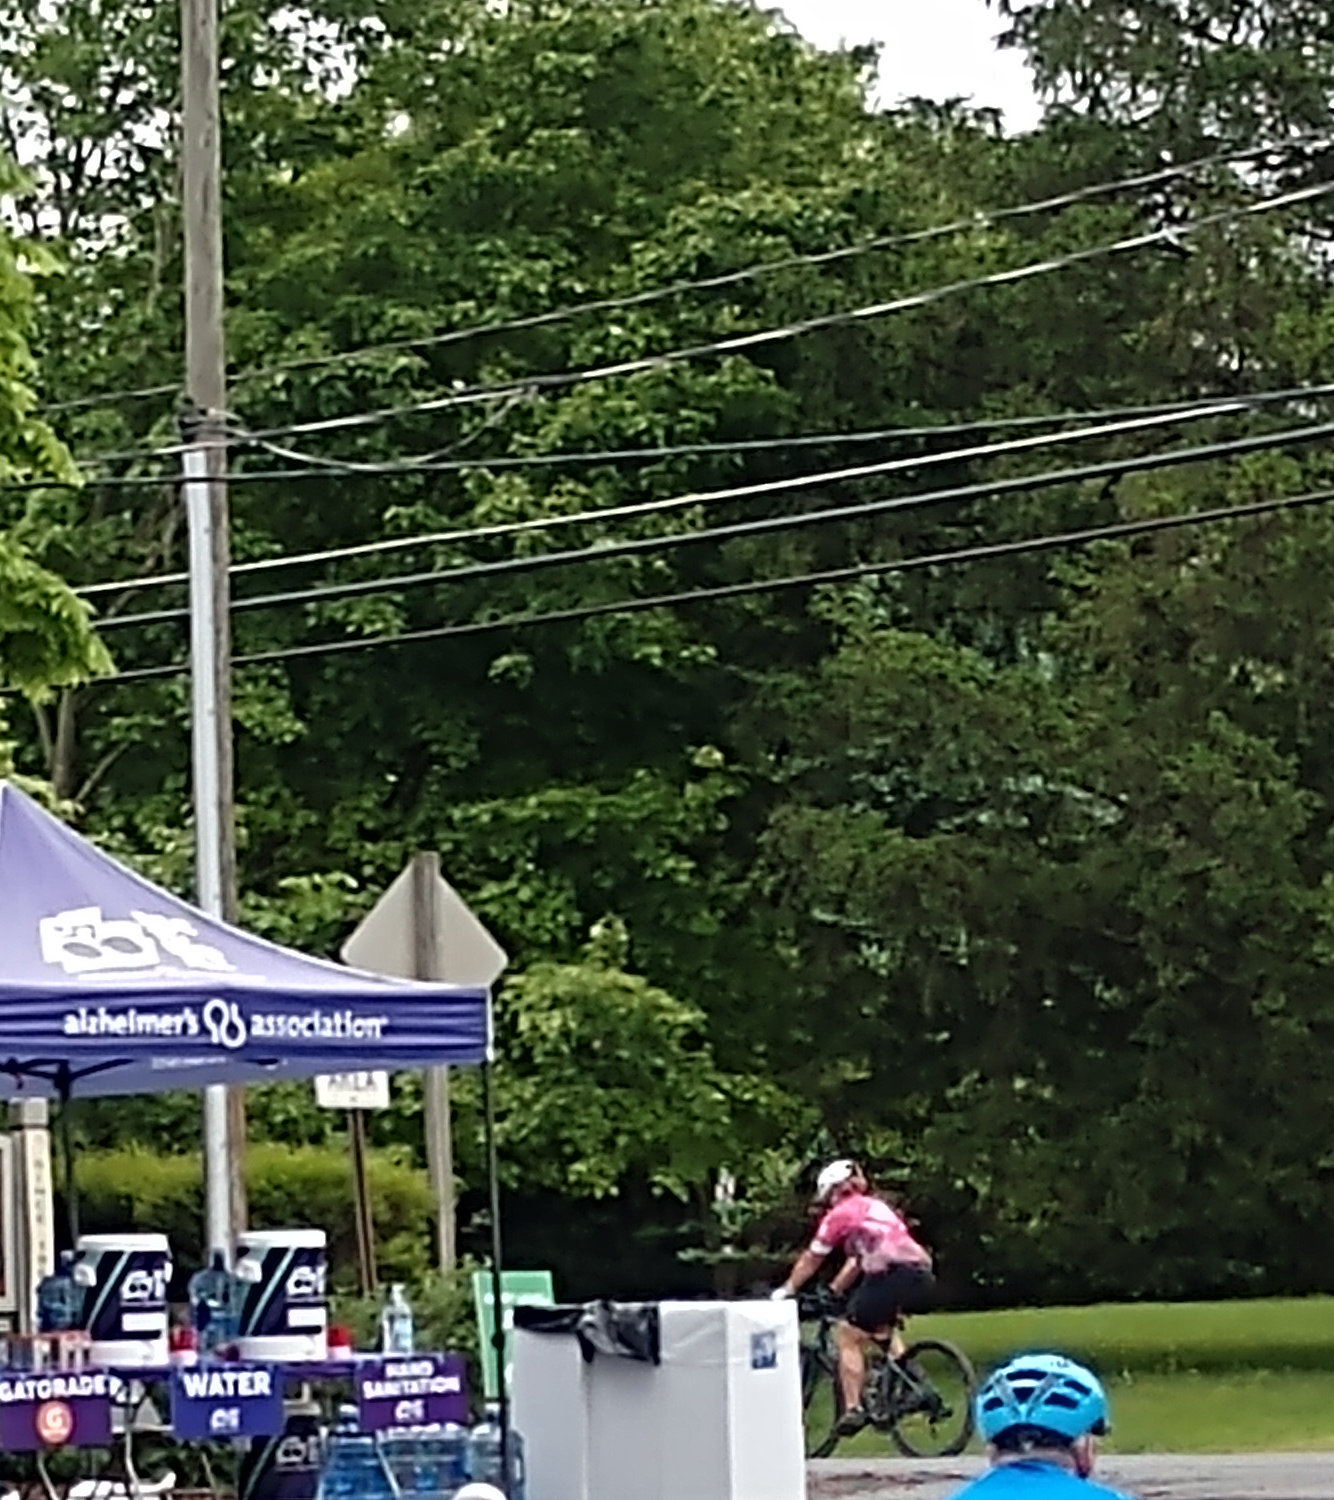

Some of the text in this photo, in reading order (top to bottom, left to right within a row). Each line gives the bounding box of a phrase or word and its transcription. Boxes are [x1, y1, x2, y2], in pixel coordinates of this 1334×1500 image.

[64, 1007, 381, 1037] alzheimer's association
[183, 1372, 272, 1397] WATER
